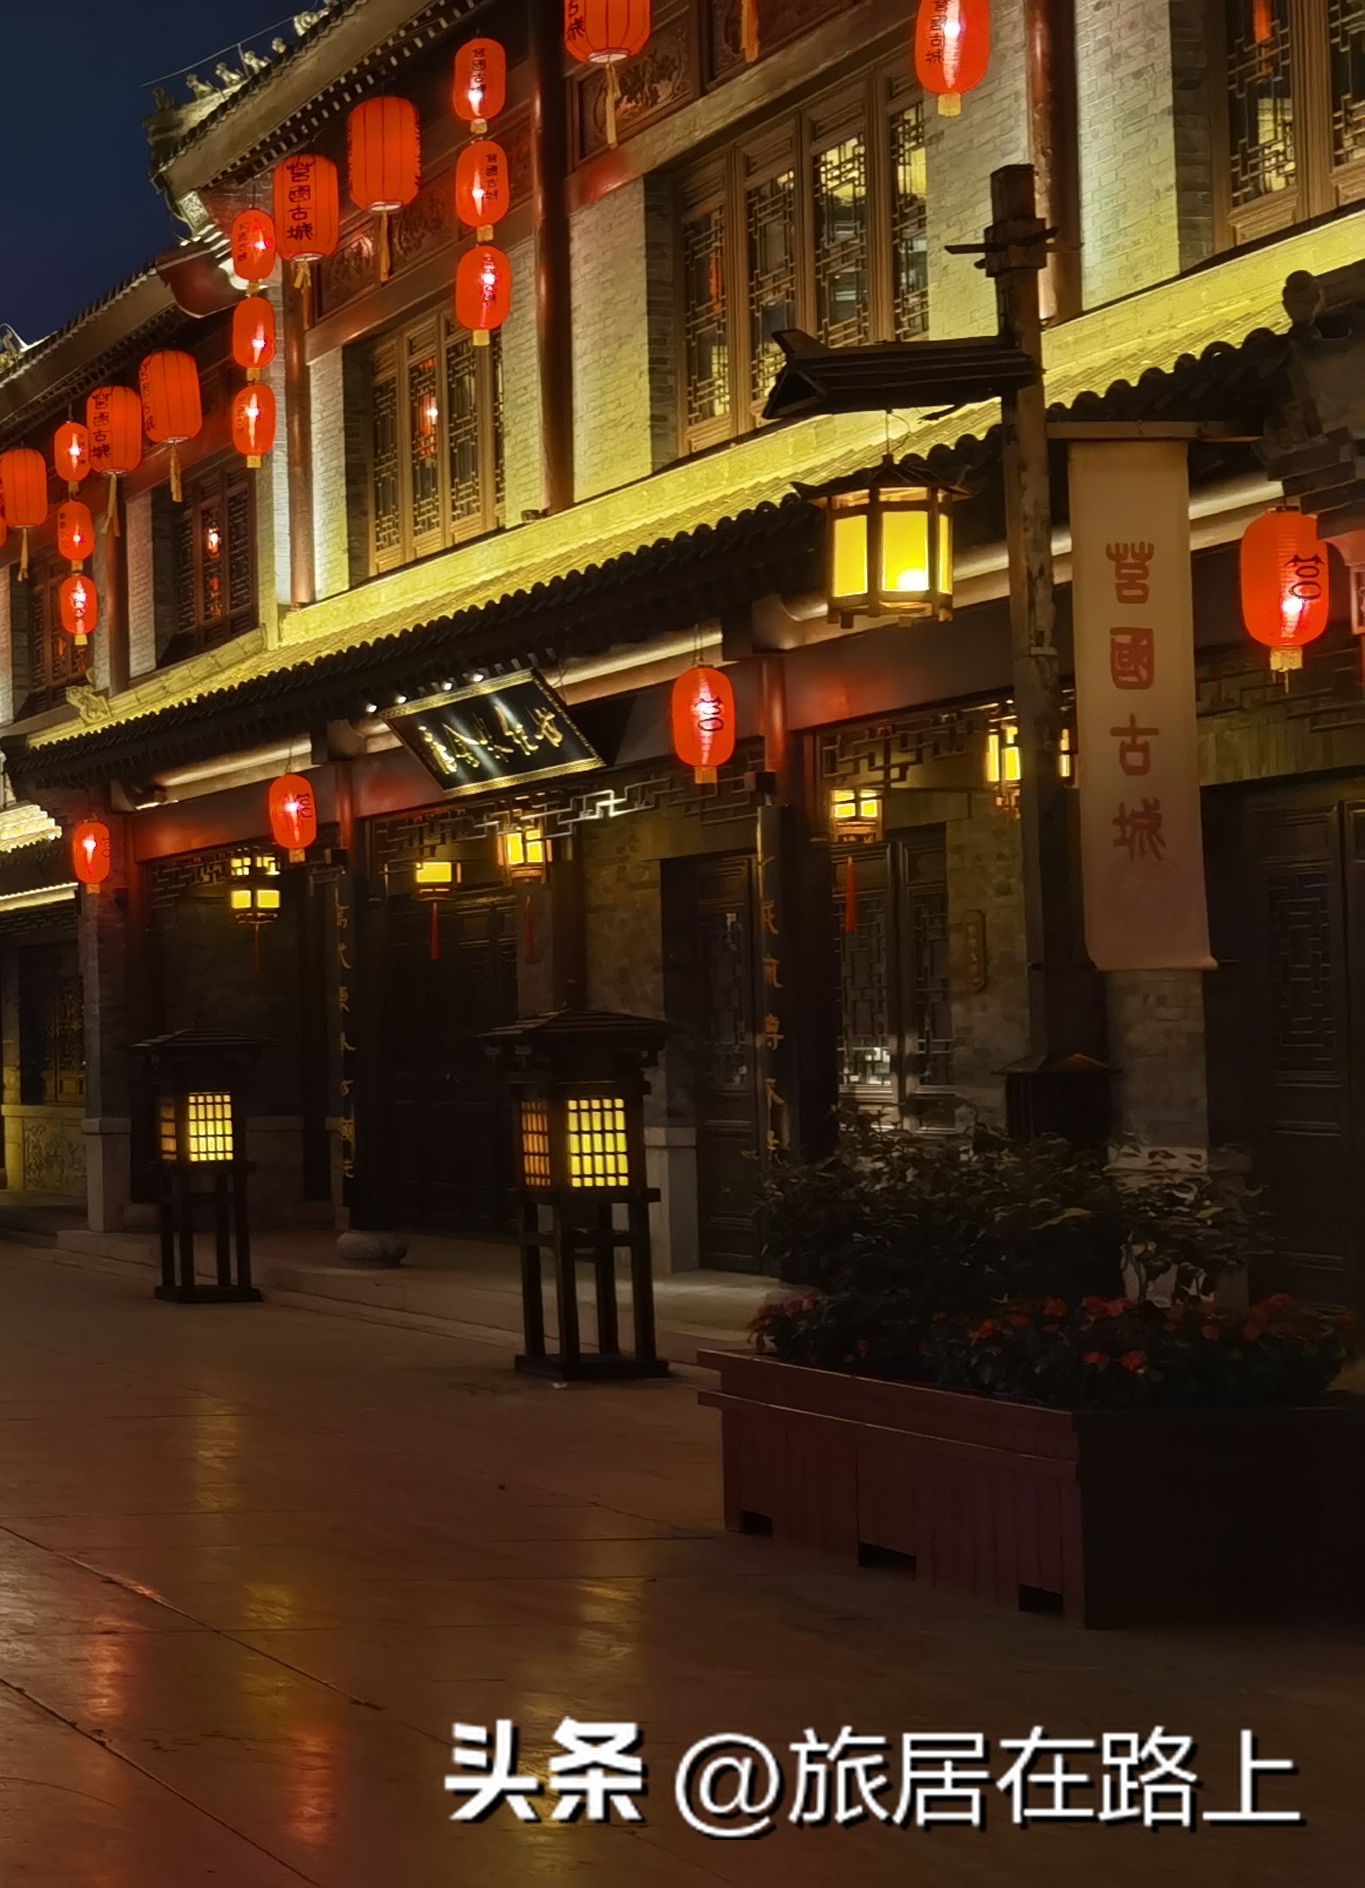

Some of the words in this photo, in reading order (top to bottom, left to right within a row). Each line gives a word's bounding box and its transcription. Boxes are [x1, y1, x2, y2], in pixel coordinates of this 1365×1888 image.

[286, 156, 314, 241] 莒國古城
[1106, 541, 1167, 862] 莒國古城
